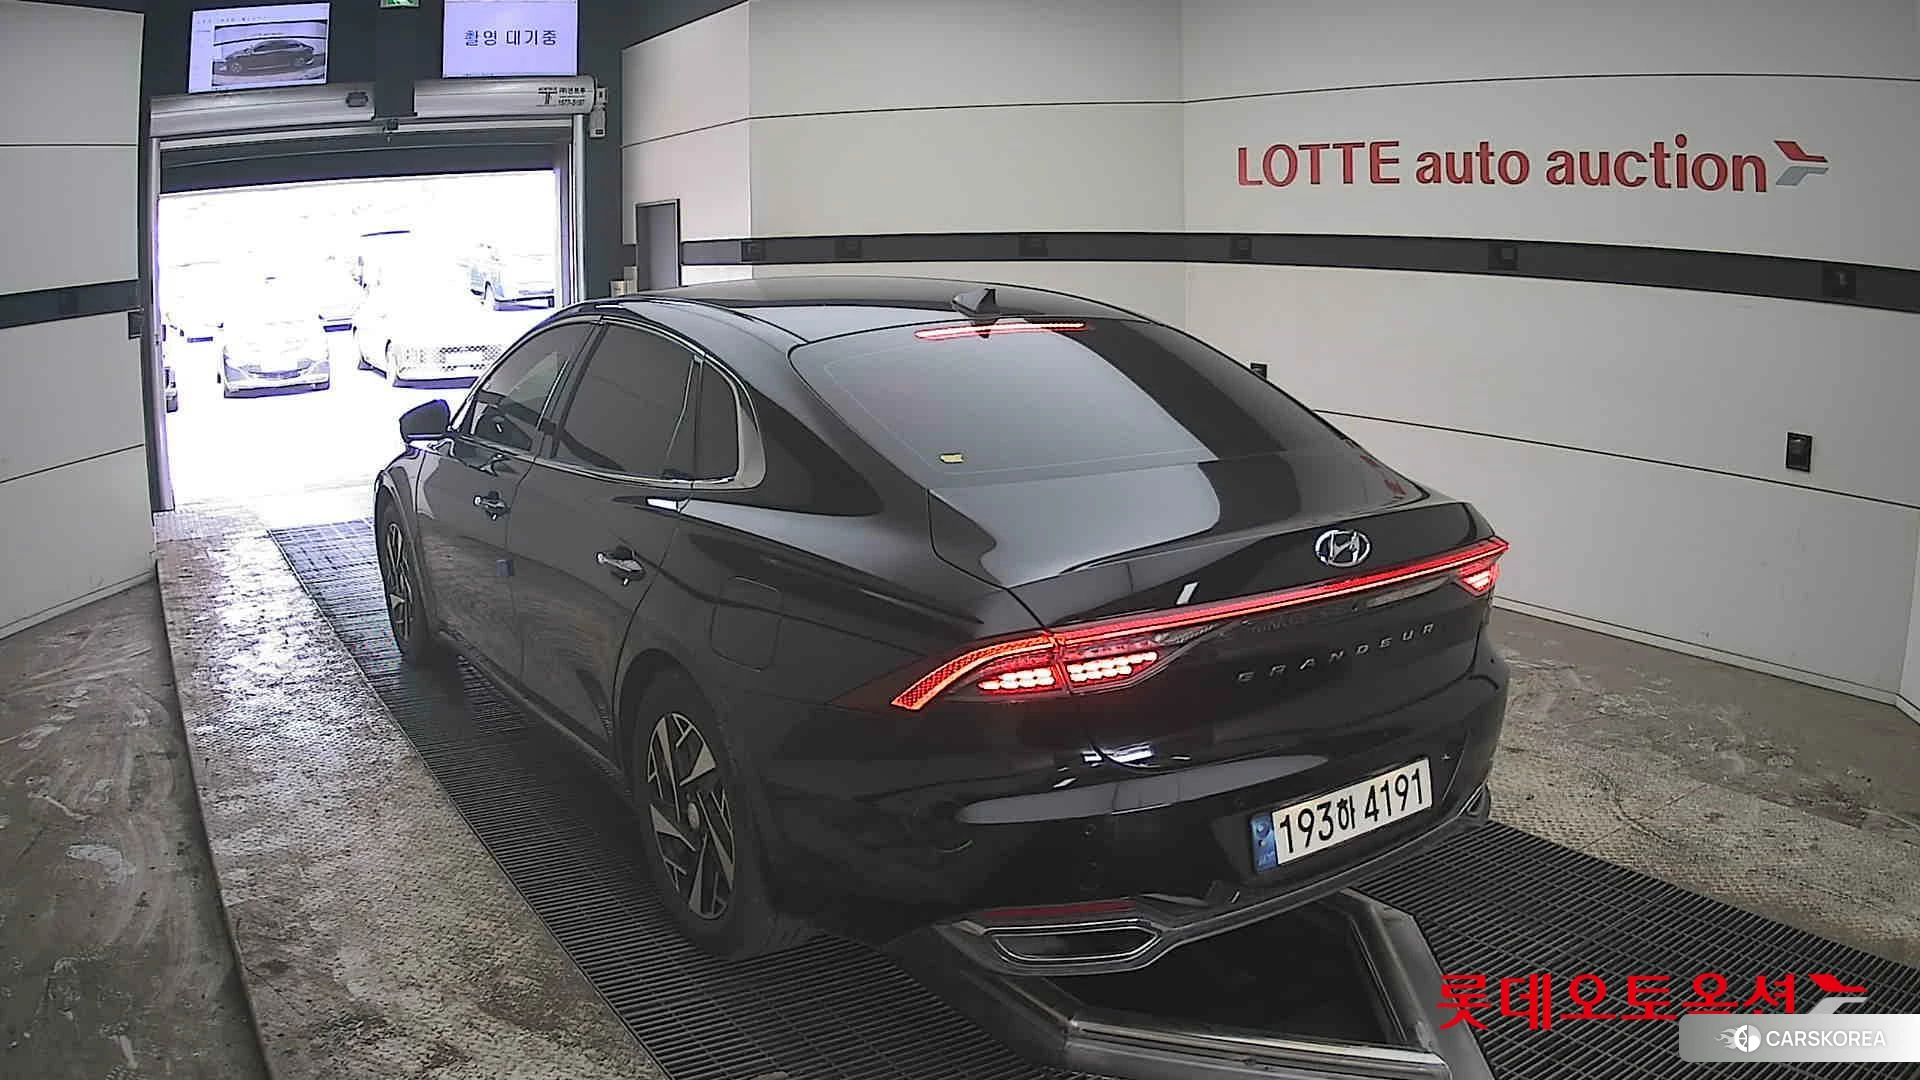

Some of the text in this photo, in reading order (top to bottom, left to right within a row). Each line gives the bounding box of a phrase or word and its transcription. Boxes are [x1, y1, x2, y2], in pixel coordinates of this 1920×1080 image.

[464, 29, 558, 47] 촬영 대기중
[1237, 134, 1767, 193] LOTTE auto auction
[1236, 622, 1435, 682] GRANDEUR
[1279, 768, 1424, 854] 193하 4191
